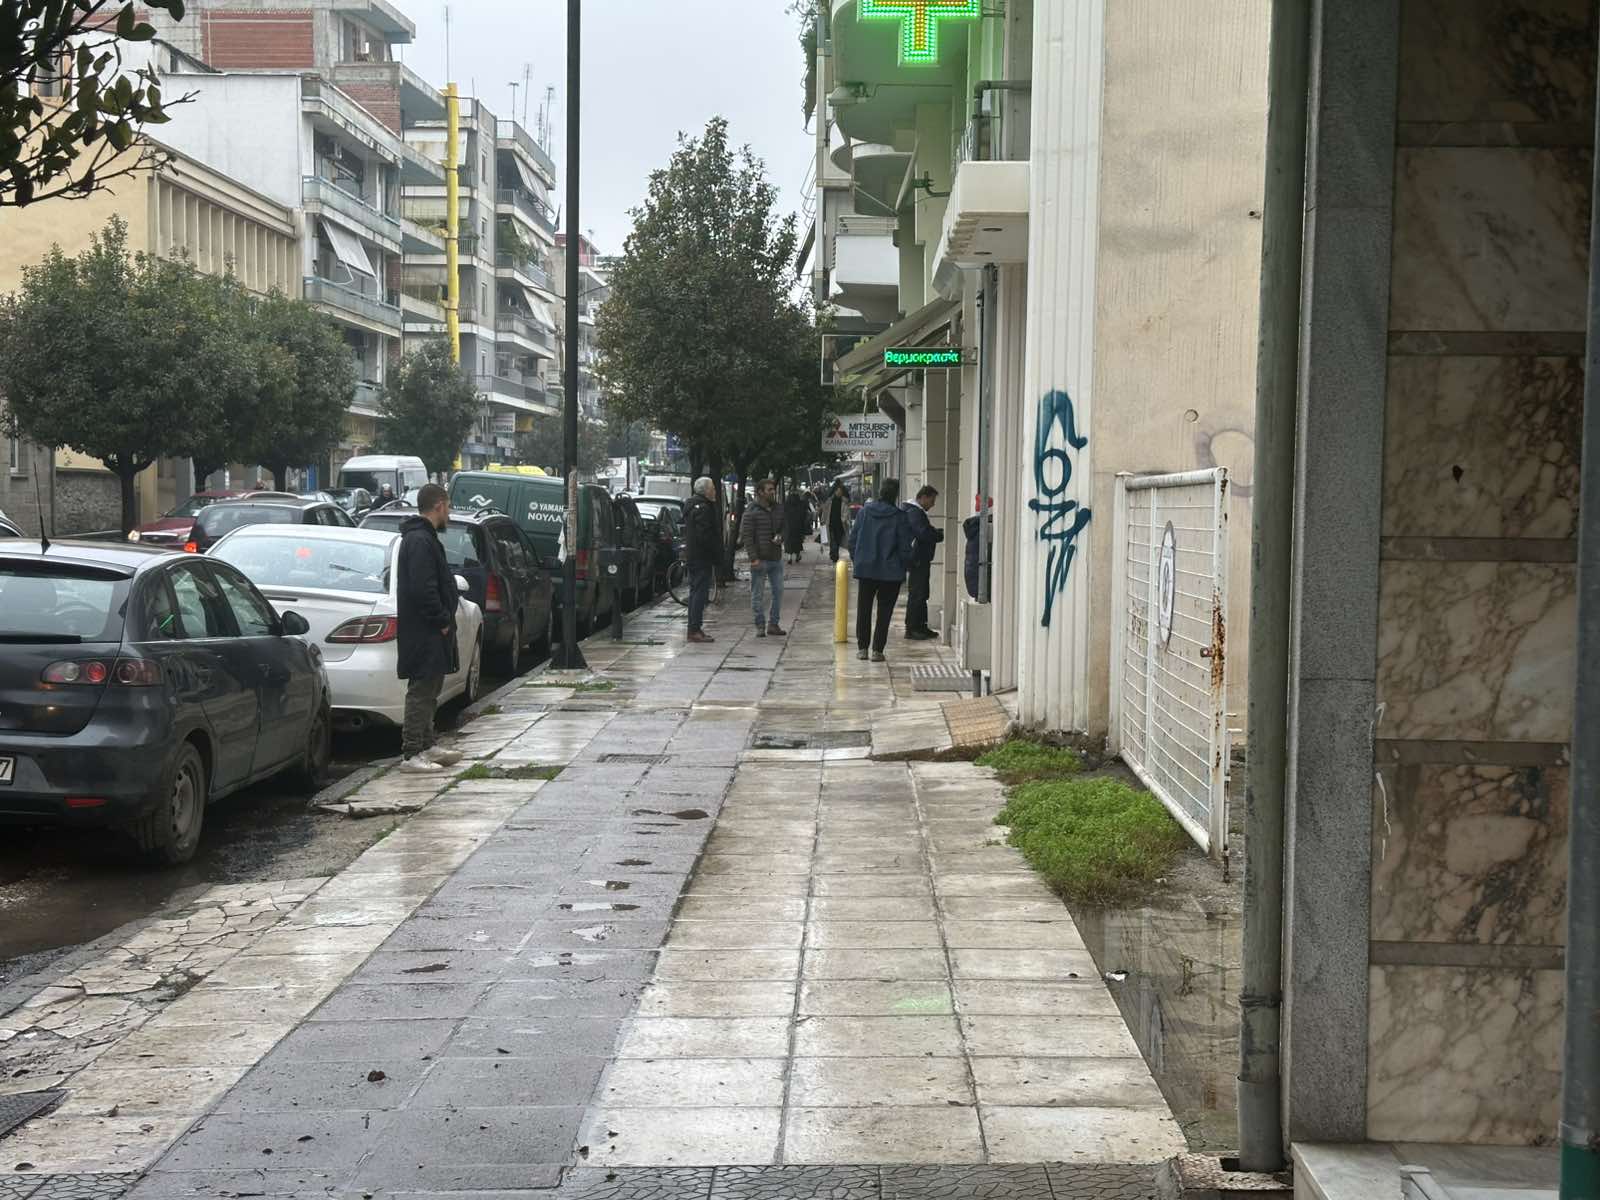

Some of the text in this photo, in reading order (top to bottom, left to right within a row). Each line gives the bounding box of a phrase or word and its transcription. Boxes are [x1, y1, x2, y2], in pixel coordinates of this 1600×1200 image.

[848, 423, 896, 431] MITSUBISHI
[848, 431, 889, 439] ELECTRIC
[539, 503, 564, 513] YAMAH
